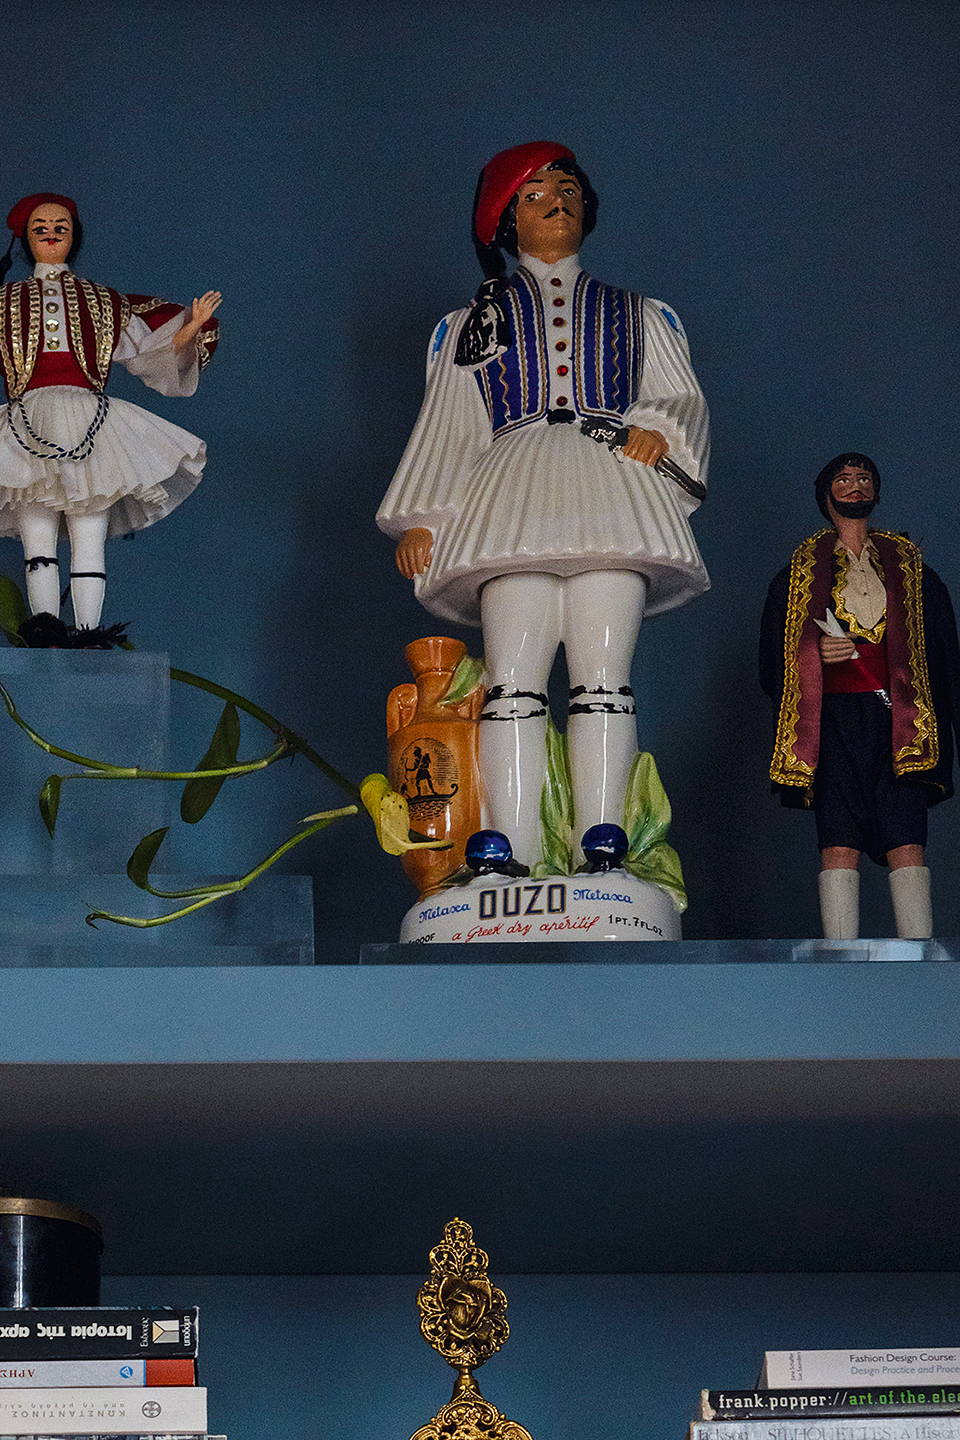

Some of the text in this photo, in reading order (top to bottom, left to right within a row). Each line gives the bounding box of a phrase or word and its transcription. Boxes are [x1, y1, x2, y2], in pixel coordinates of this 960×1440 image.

[479, 883, 567, 920] OUZO
[572, 888, 633, 904] Metaxa
[419, 902, 471, 923] Metaxa
[507, 920, 531, 937] dry
[71, 1322, 132, 1340] Ιστορία
[849, 1353, 956, 1364] Fashion Design Course:
[0, 1368, 36, 1378] ΑΡΗΣ
[851, 1366, 935, 1377] Design Practice and
[12, 1410, 126, 1418] ΚΩΝΣΤΑΝΤΙΝΟΣ
